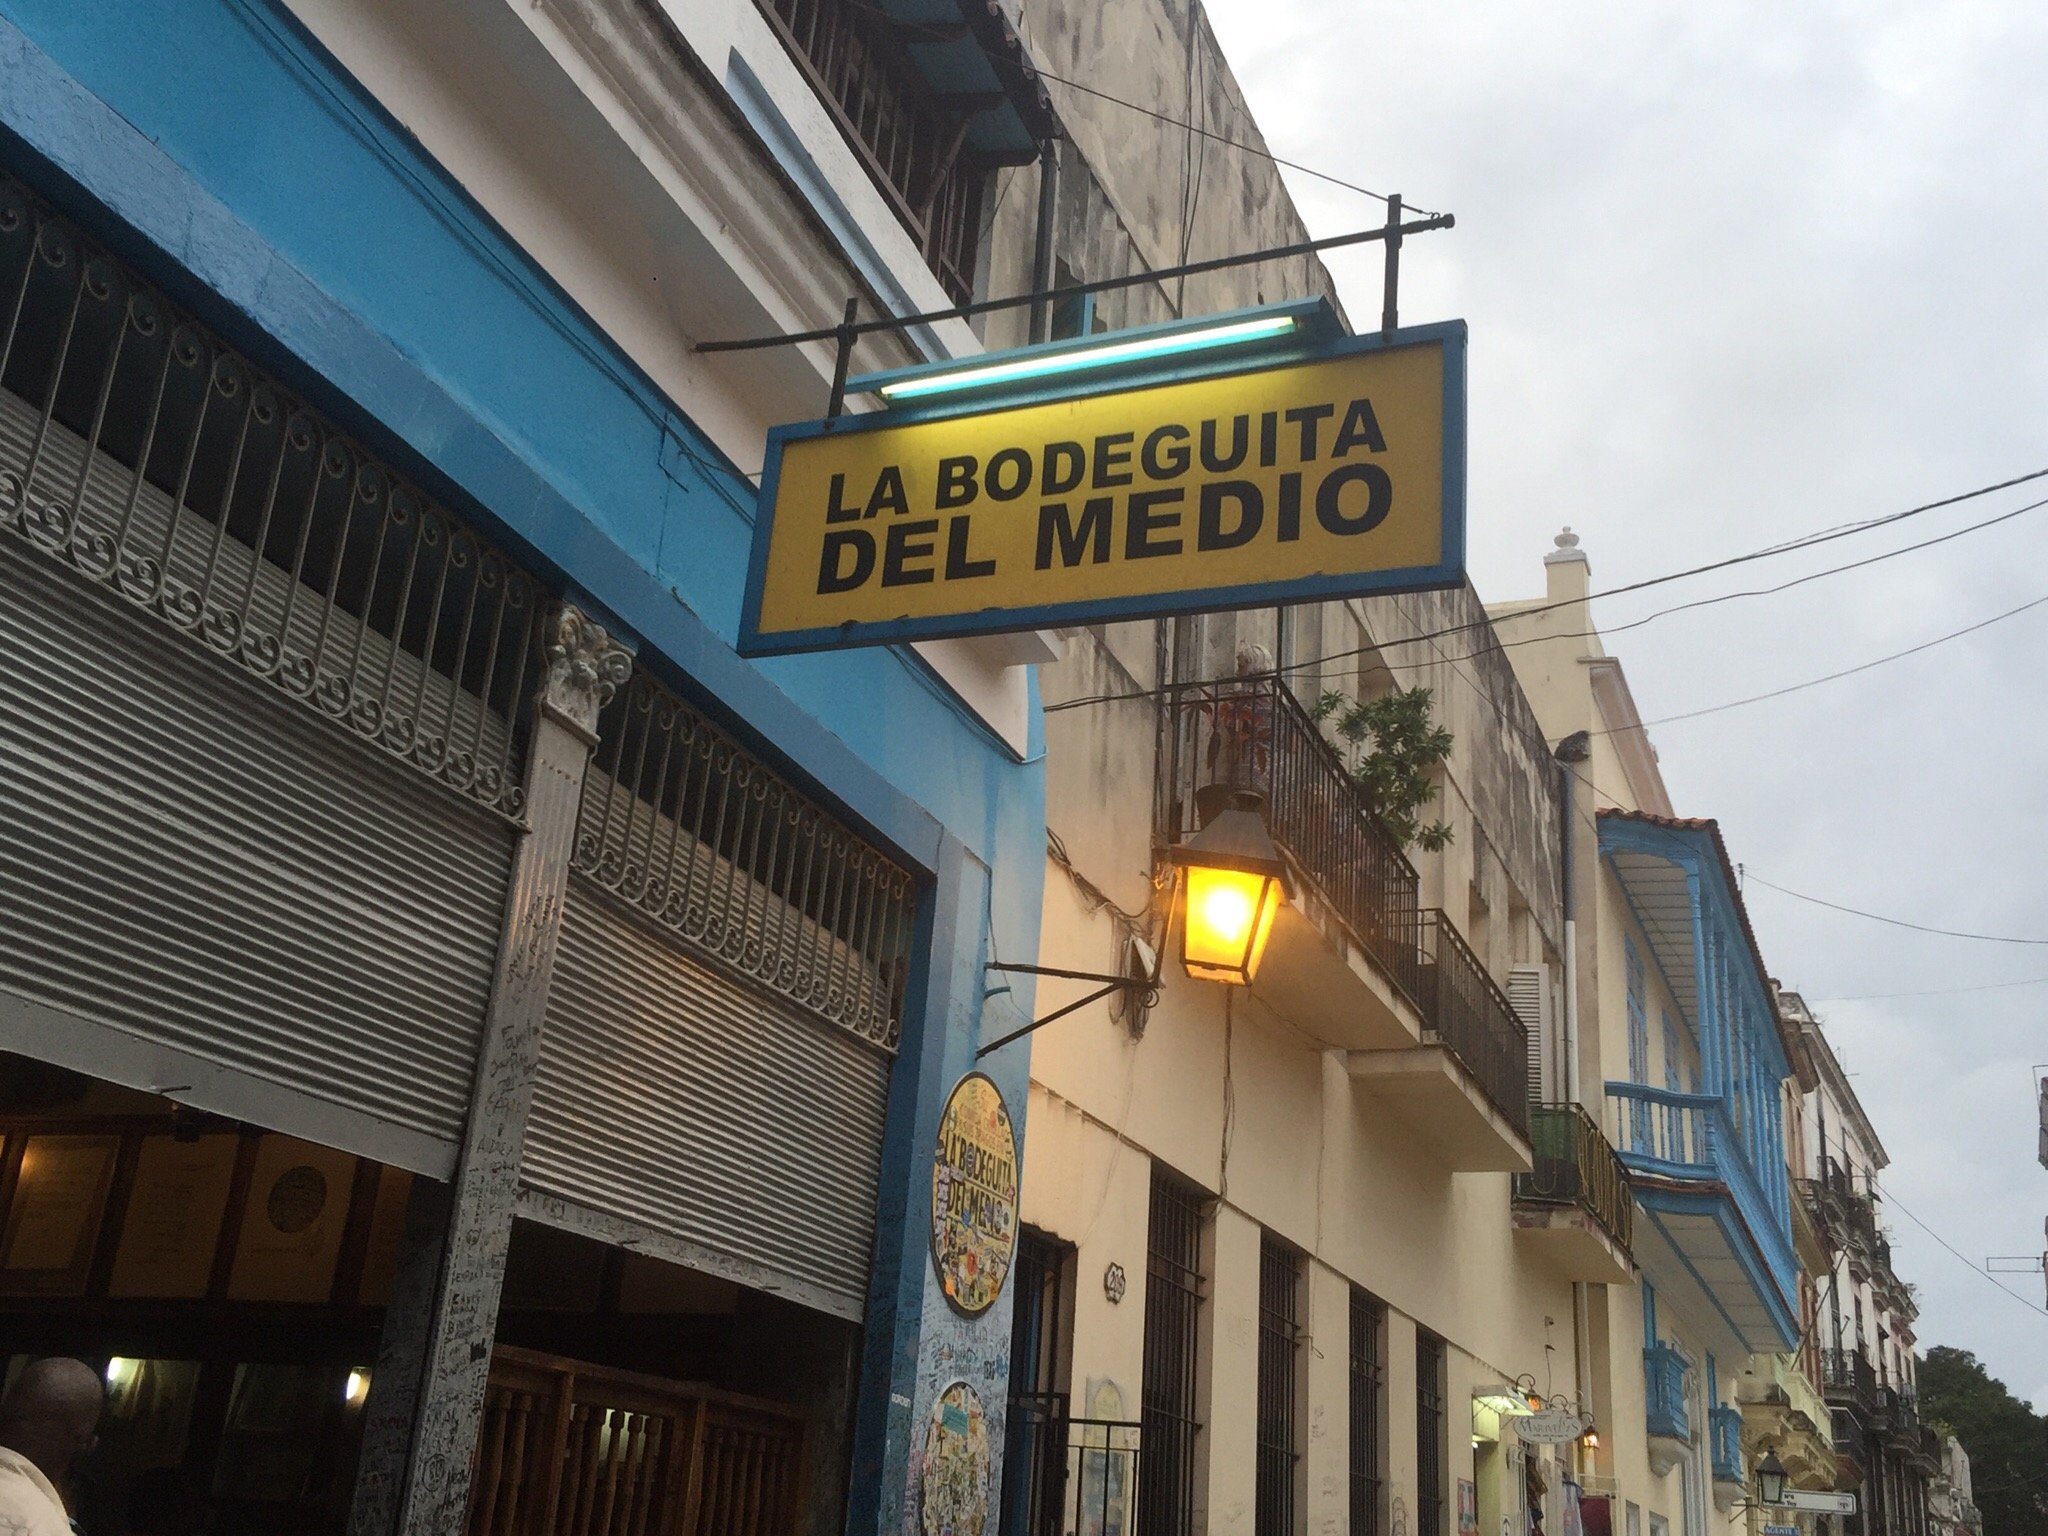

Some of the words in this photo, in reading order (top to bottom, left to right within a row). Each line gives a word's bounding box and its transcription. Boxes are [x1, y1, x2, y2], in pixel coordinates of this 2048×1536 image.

[825, 465, 909, 524] LA
[935, 399, 1387, 510] BODEGUITA
[817, 515, 996, 595] DEL
[1034, 462, 1392, 571] MEDIO
